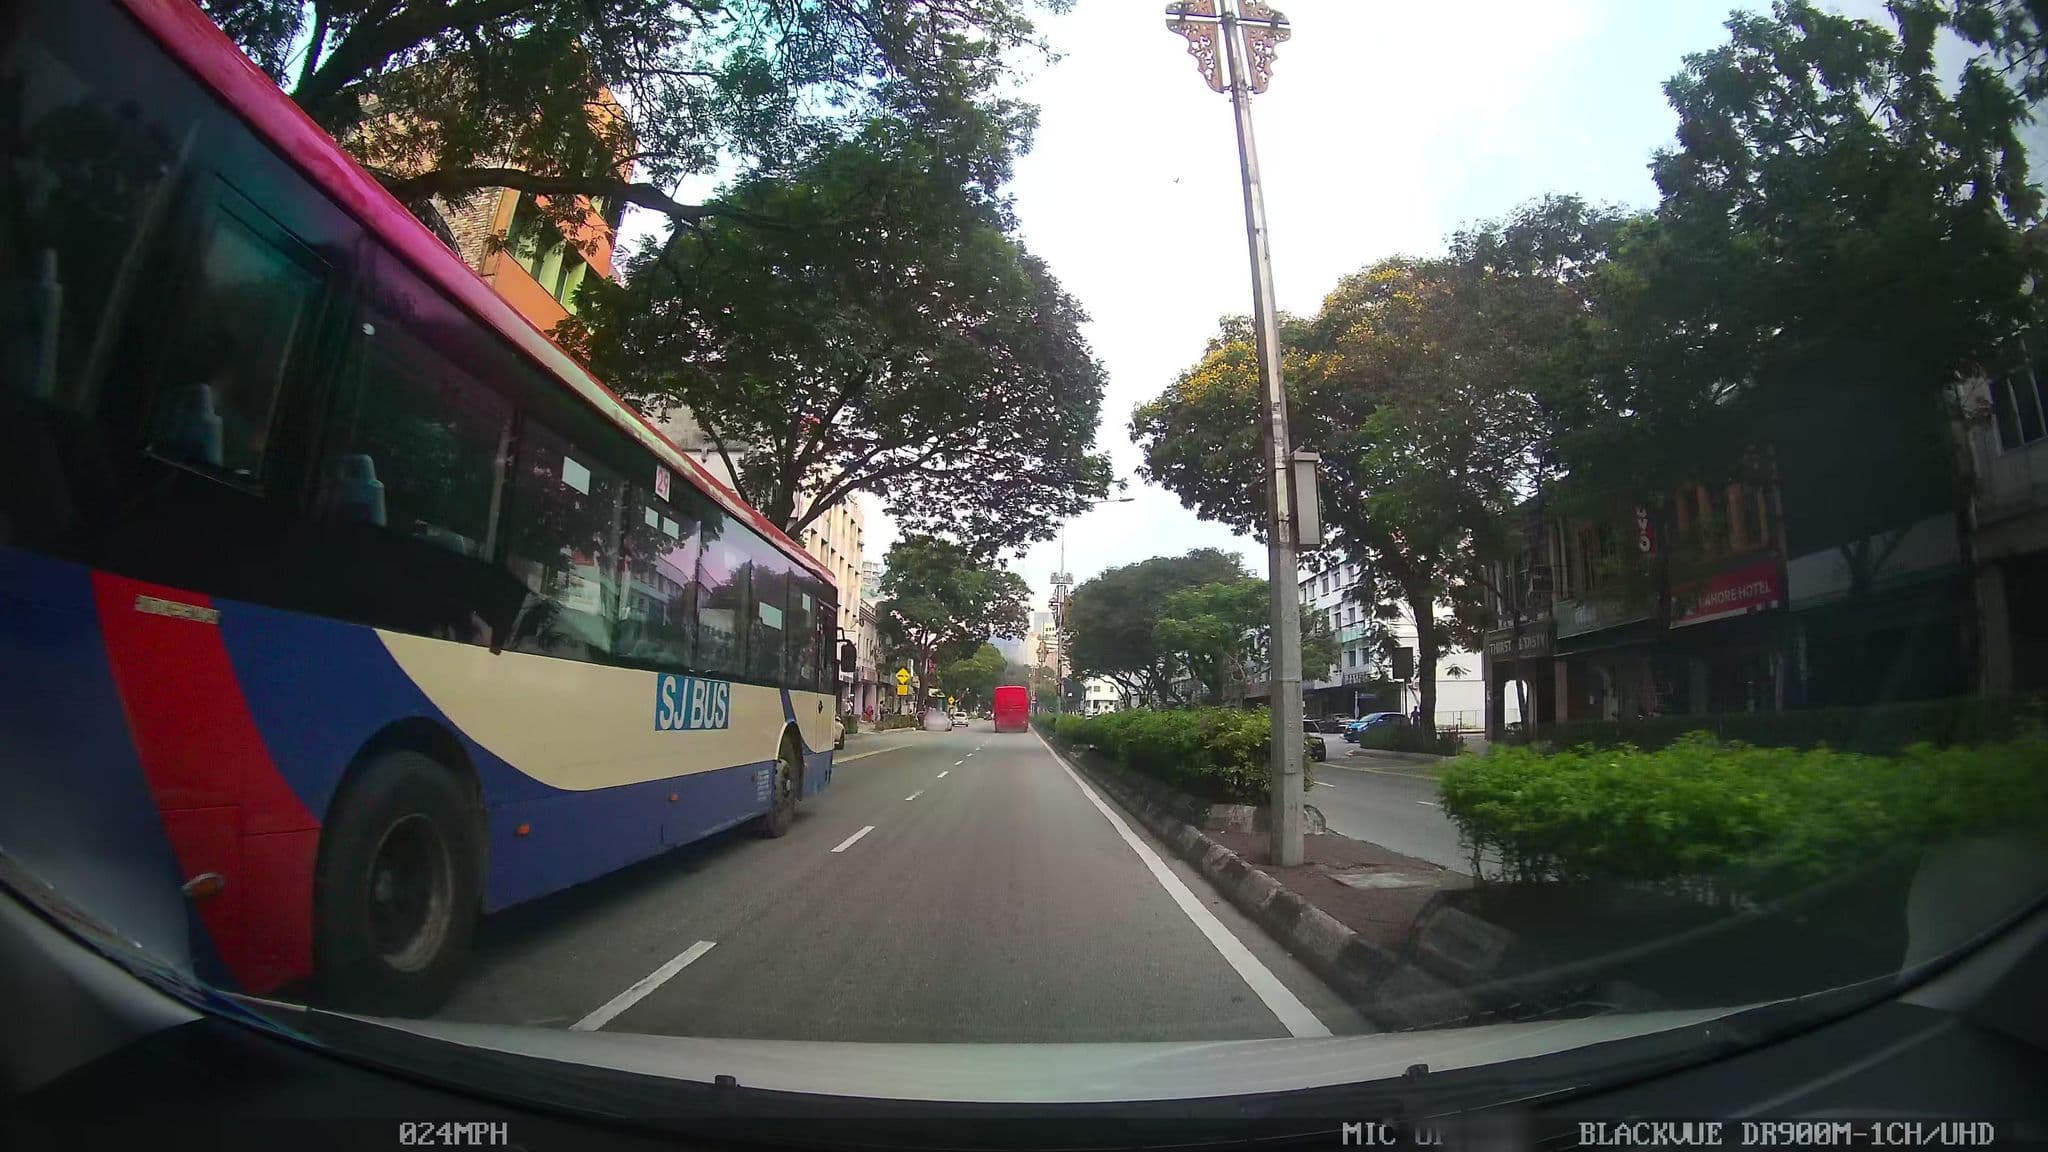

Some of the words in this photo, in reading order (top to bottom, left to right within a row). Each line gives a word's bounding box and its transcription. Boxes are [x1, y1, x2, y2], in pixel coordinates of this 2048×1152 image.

[1738, 580, 1771, 600] HOTEL
[660, 676, 689, 729] SJ
[690, 680, 728, 729] BUS
